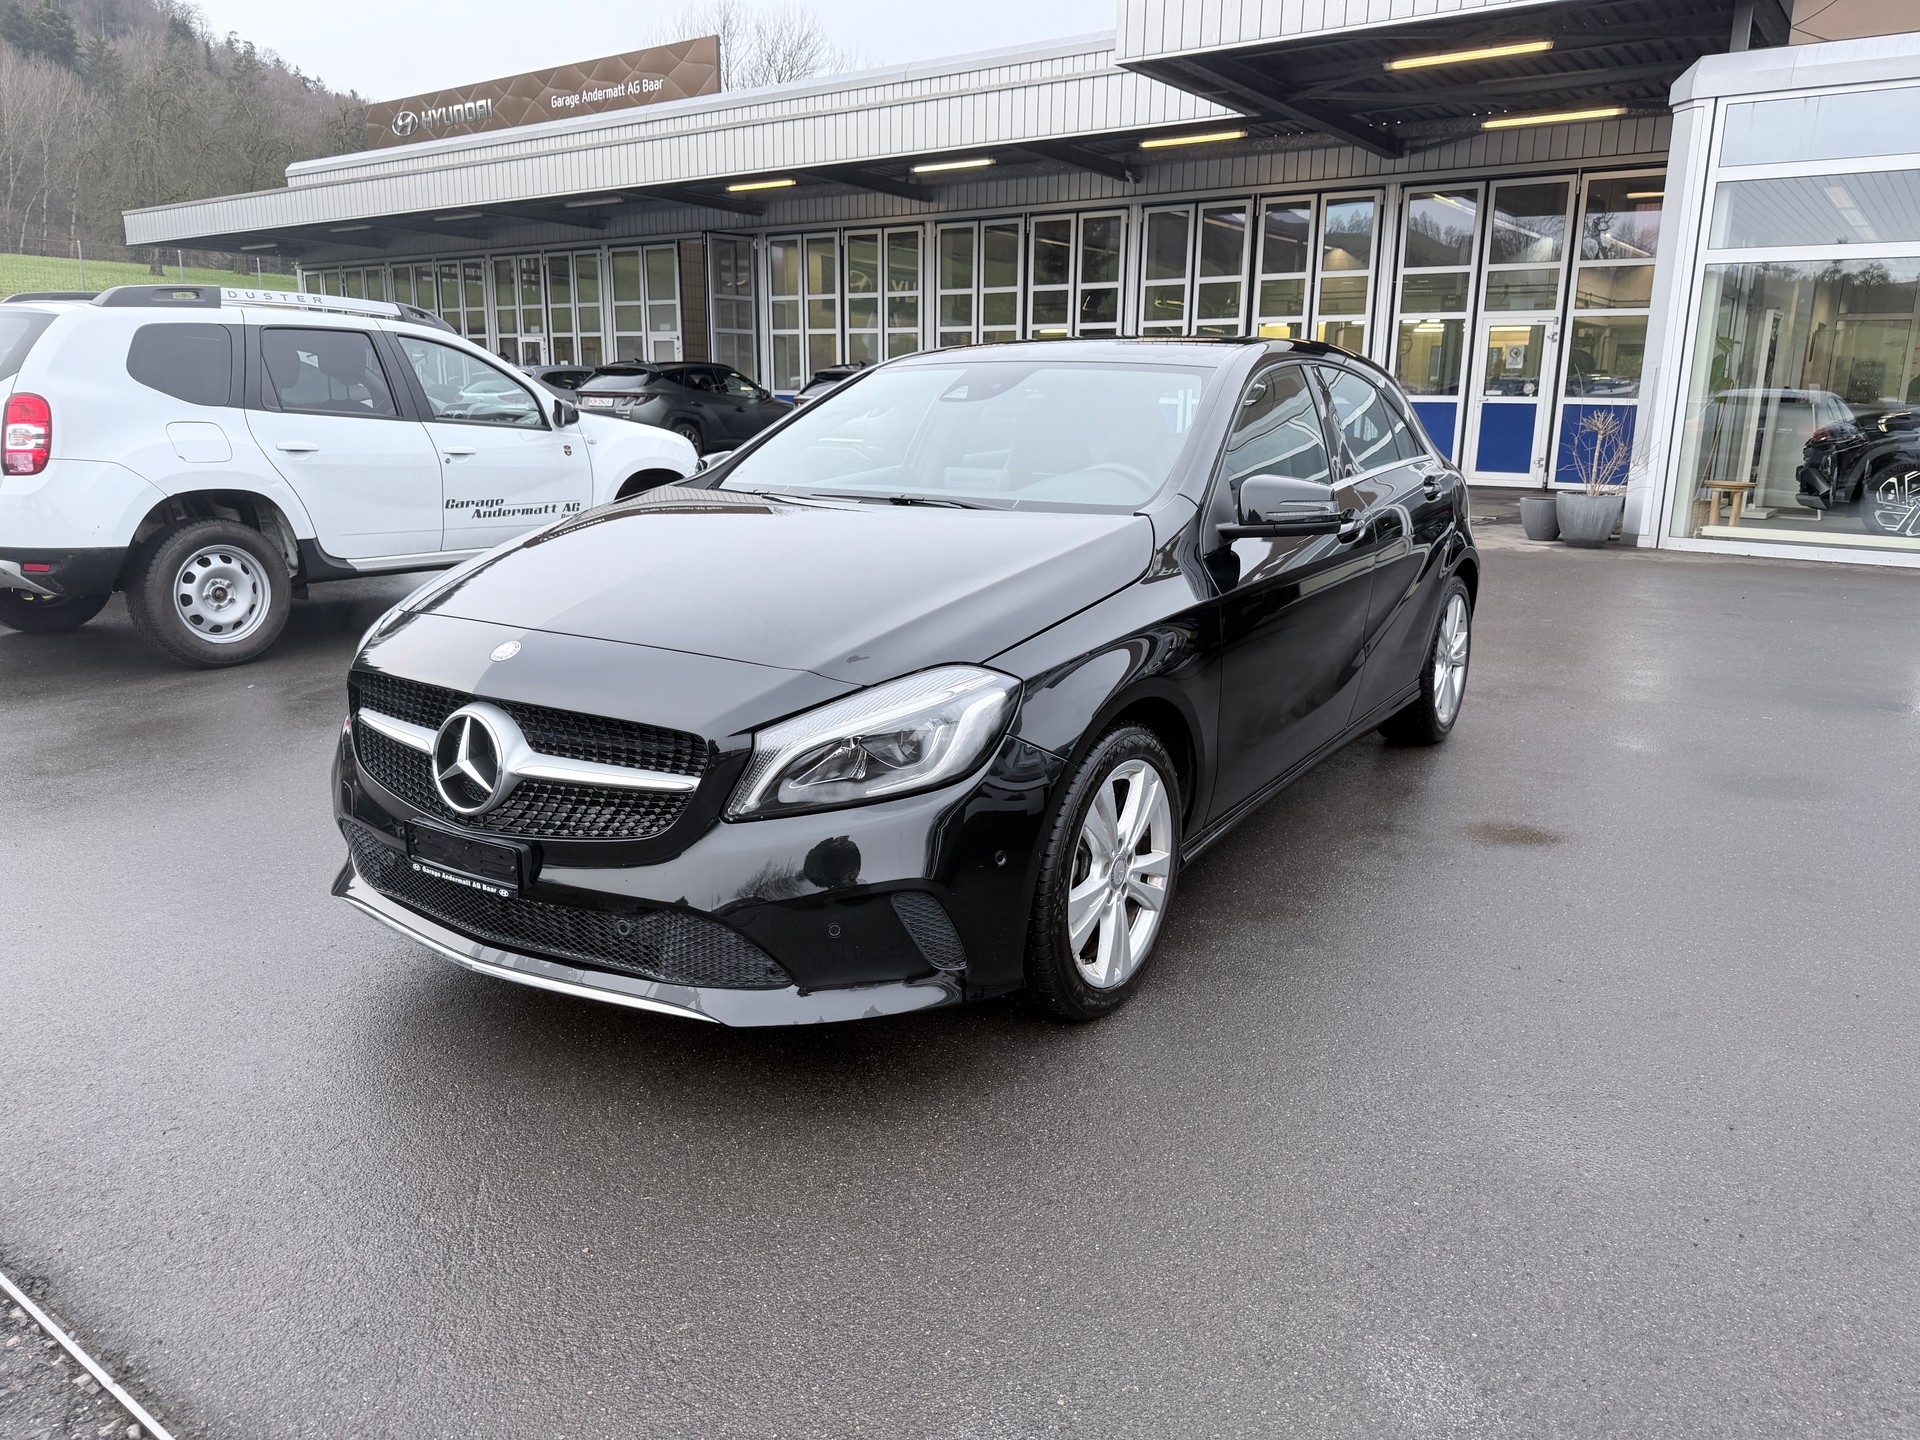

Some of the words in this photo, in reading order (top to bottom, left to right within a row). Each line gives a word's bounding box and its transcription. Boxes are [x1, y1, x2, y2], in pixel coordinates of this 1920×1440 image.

[551, 94, 580, 108] Garage
[582, 84, 625, 104] Andermatt
[627, 80, 640, 96] AG
[642, 78, 664, 92] Baar
[421, 98, 493, 129] HYUNDAI
[227, 290, 323, 304] DUSTER
[444, 498, 505, 510] Garage
[471, 503, 558, 519] Andermatt
[562, 502, 581, 513] AG
[422, 866, 441, 877] Garage
[441, 872, 471, 886] Andermatt
[472, 881, 481, 889] AG
[482, 884, 497, 893] Baar
